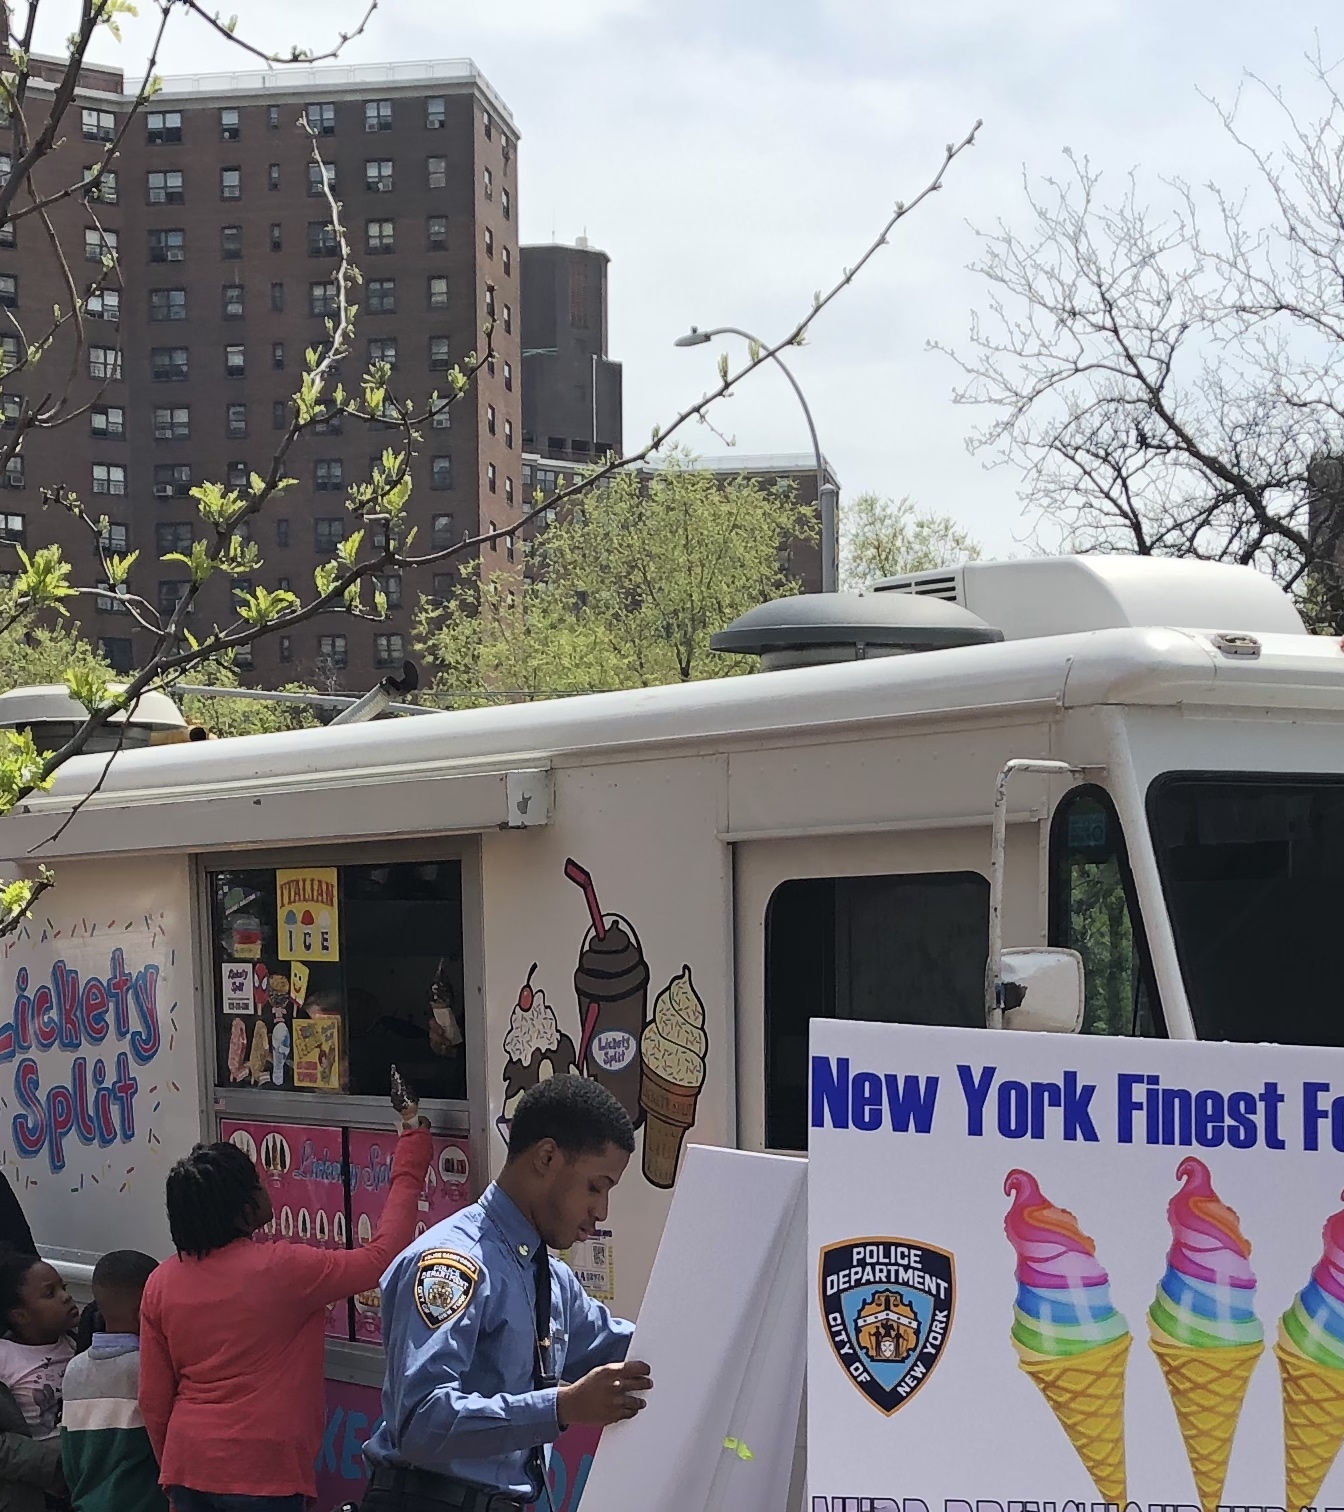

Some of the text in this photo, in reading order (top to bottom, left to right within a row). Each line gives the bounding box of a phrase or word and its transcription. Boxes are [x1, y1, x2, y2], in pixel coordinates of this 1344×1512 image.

[279, 878, 334, 909] ITALIAN
[288, 929, 330, 953] ICE
[598, 1035, 631, 1051] Lickety
[603, 1050, 625, 1067] Split
[12, 1051, 138, 1174] Split
[812, 1055, 939, 1134] New
[956, 1064, 1100, 1142] York
[1117, 1073, 1285, 1151] Finest
[853, 1245, 922, 1268] POLICE
[826, 1265, 948, 1299] DEPARTMENT
[828, 1312, 871, 1383] CITY OF
[897, 1310, 948, 1397] NEW YORK
